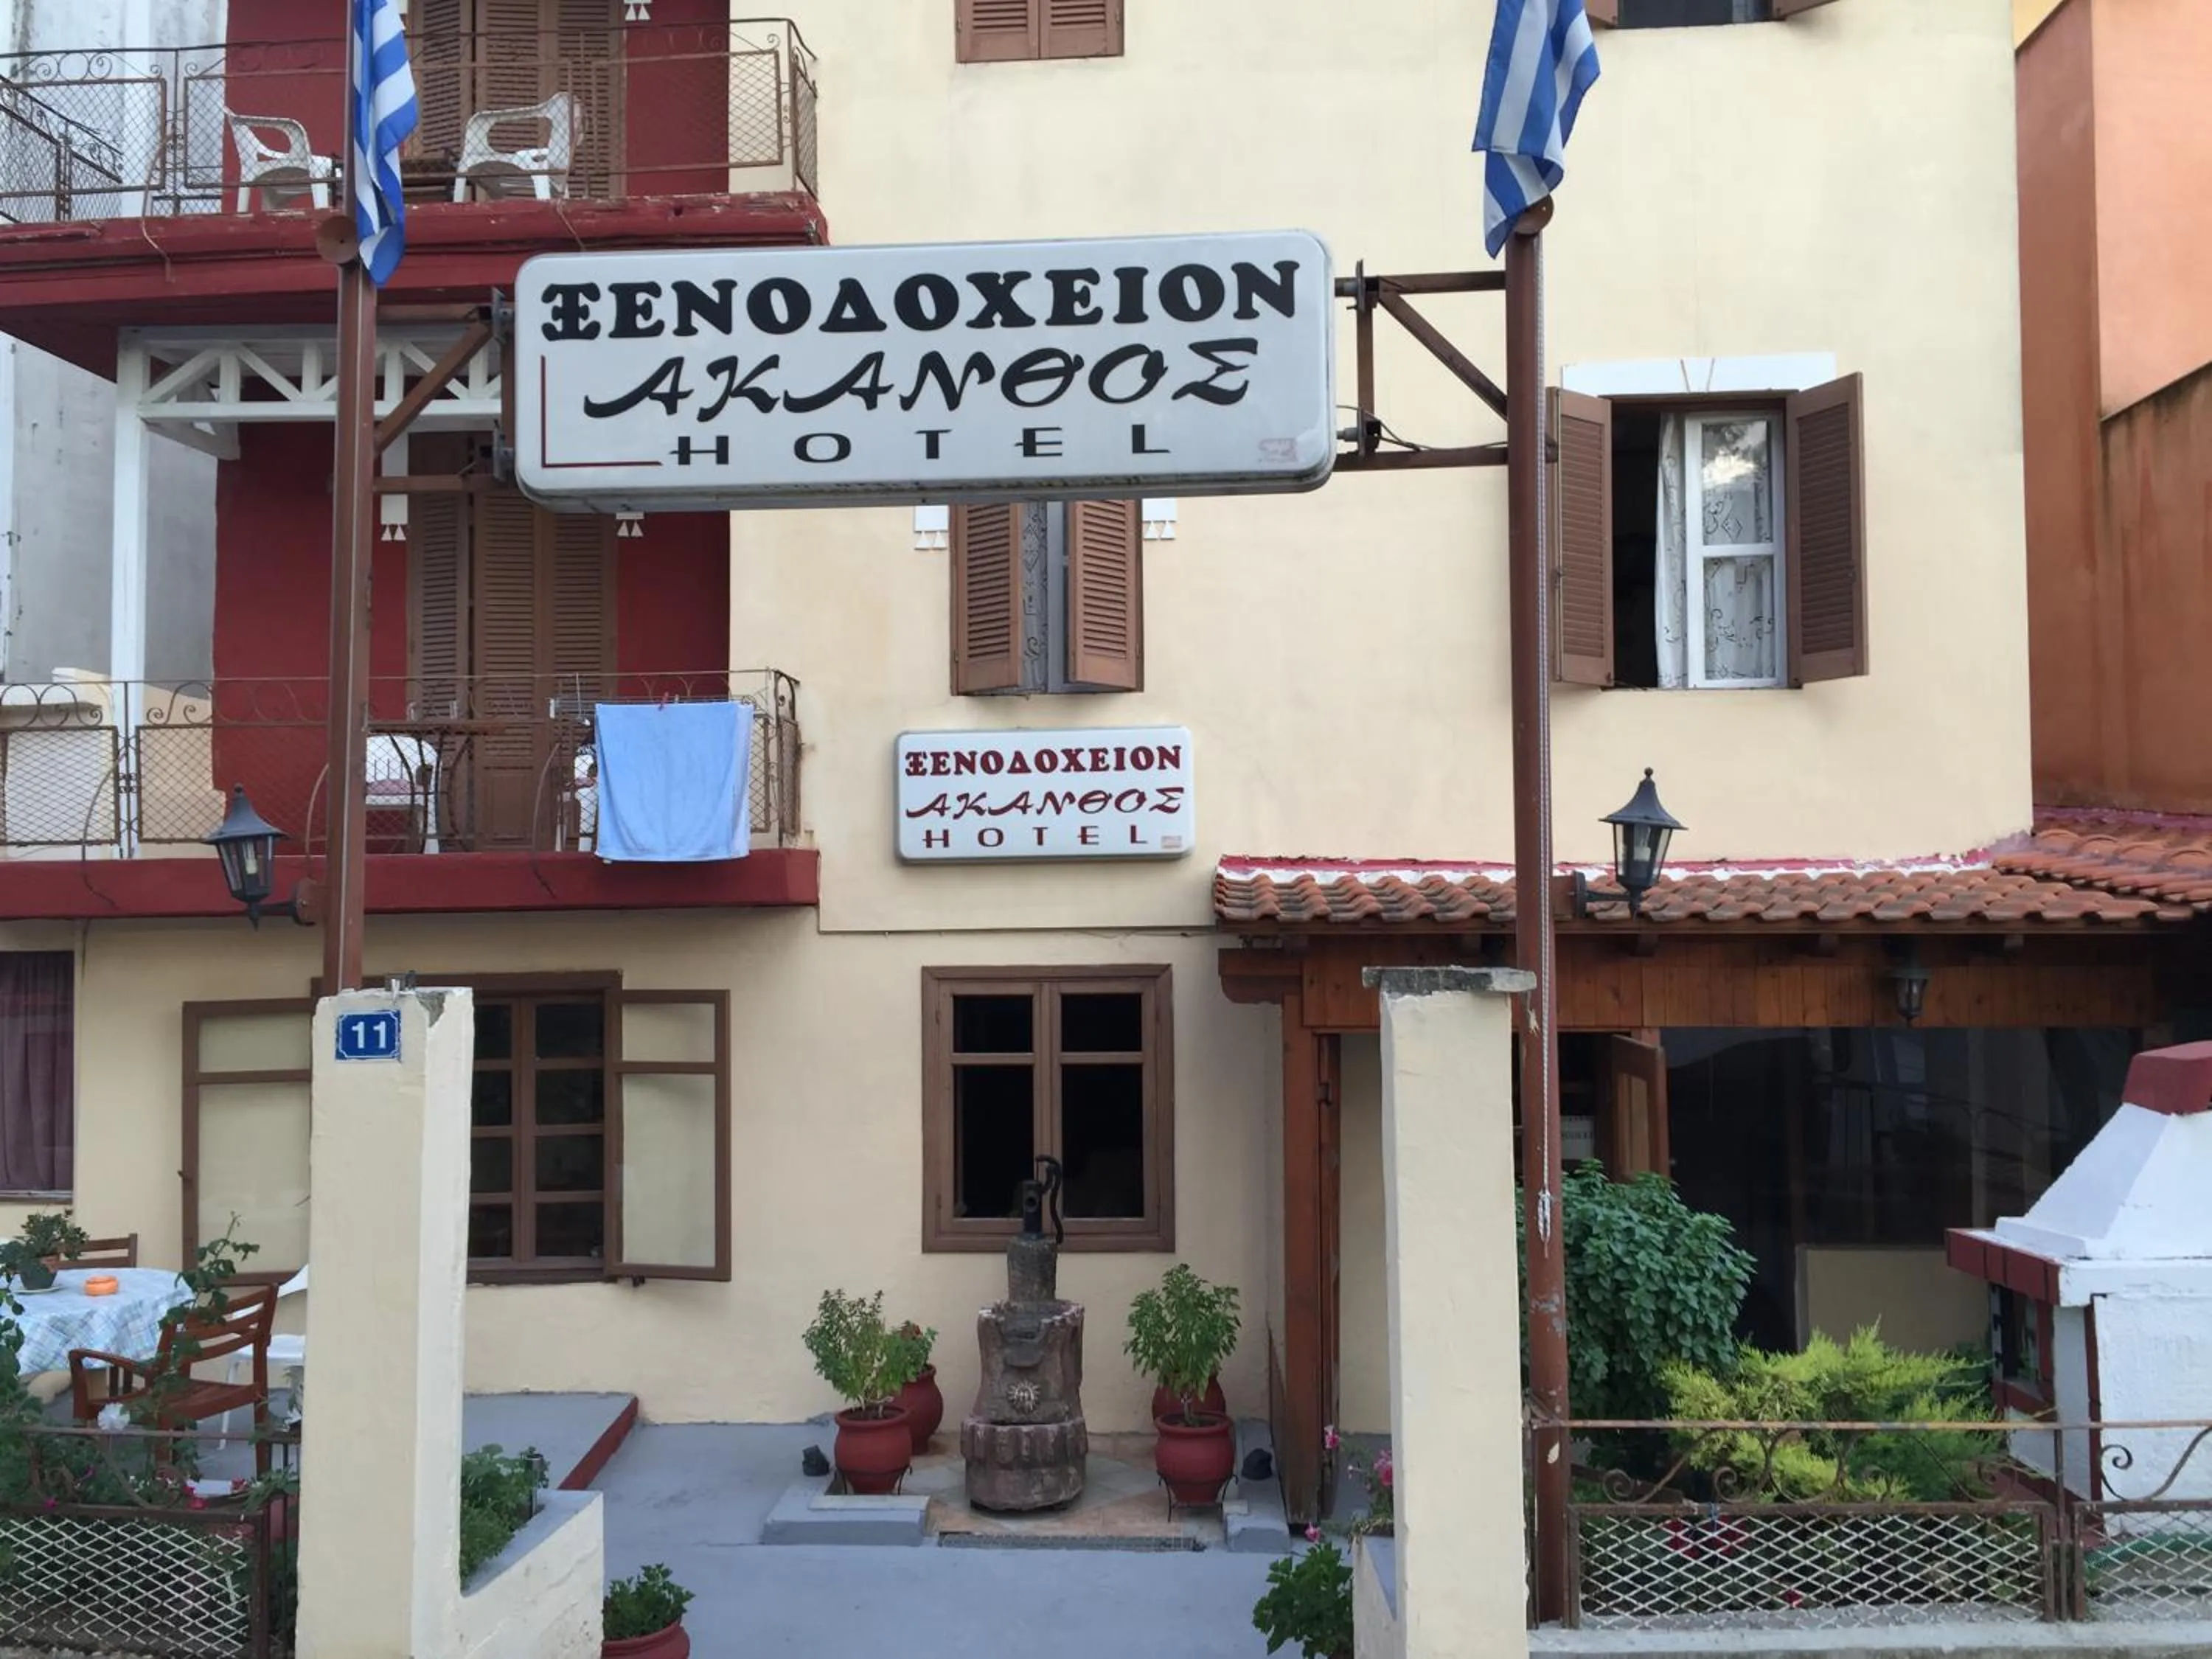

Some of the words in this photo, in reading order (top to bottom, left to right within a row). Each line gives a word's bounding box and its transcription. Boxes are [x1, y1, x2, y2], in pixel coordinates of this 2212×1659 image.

[541, 260, 1300, 341] ΞΕΝΟΔΟΧΕΙΟΝ
[582, 338, 1259, 422] ΑΚΑΝΘΟΣ
[669, 423, 1171, 465] HOTEL
[905, 745, 1181, 776] ΞΕΝΟΔΟΧΕΙΟΝ
[905, 787, 1184, 820] ΑΚΑΝΘΟΣ
[922, 824, 1148, 849] HOTEL
[351, 1020, 386, 1049] 11
